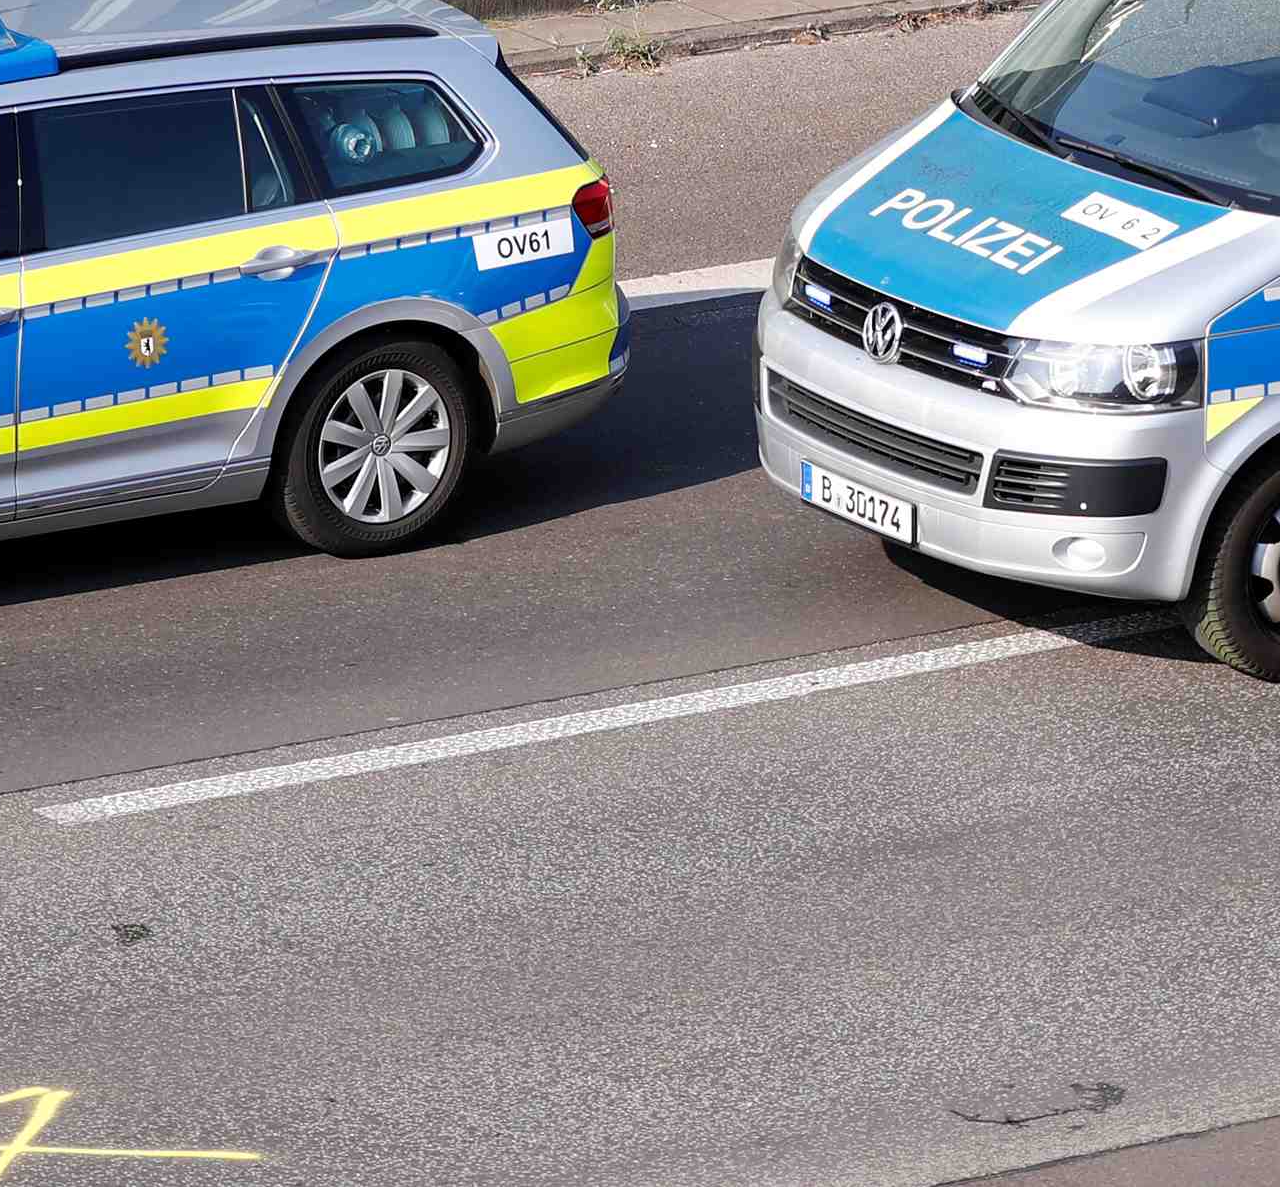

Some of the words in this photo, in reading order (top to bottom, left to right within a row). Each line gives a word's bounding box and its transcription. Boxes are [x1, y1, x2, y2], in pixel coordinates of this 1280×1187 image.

[497, 229, 550, 259] OV61
[869, 188, 1063, 275] POLIZEI
[822, 475, 832, 503] B
[846, 485, 901, 532] 30174
